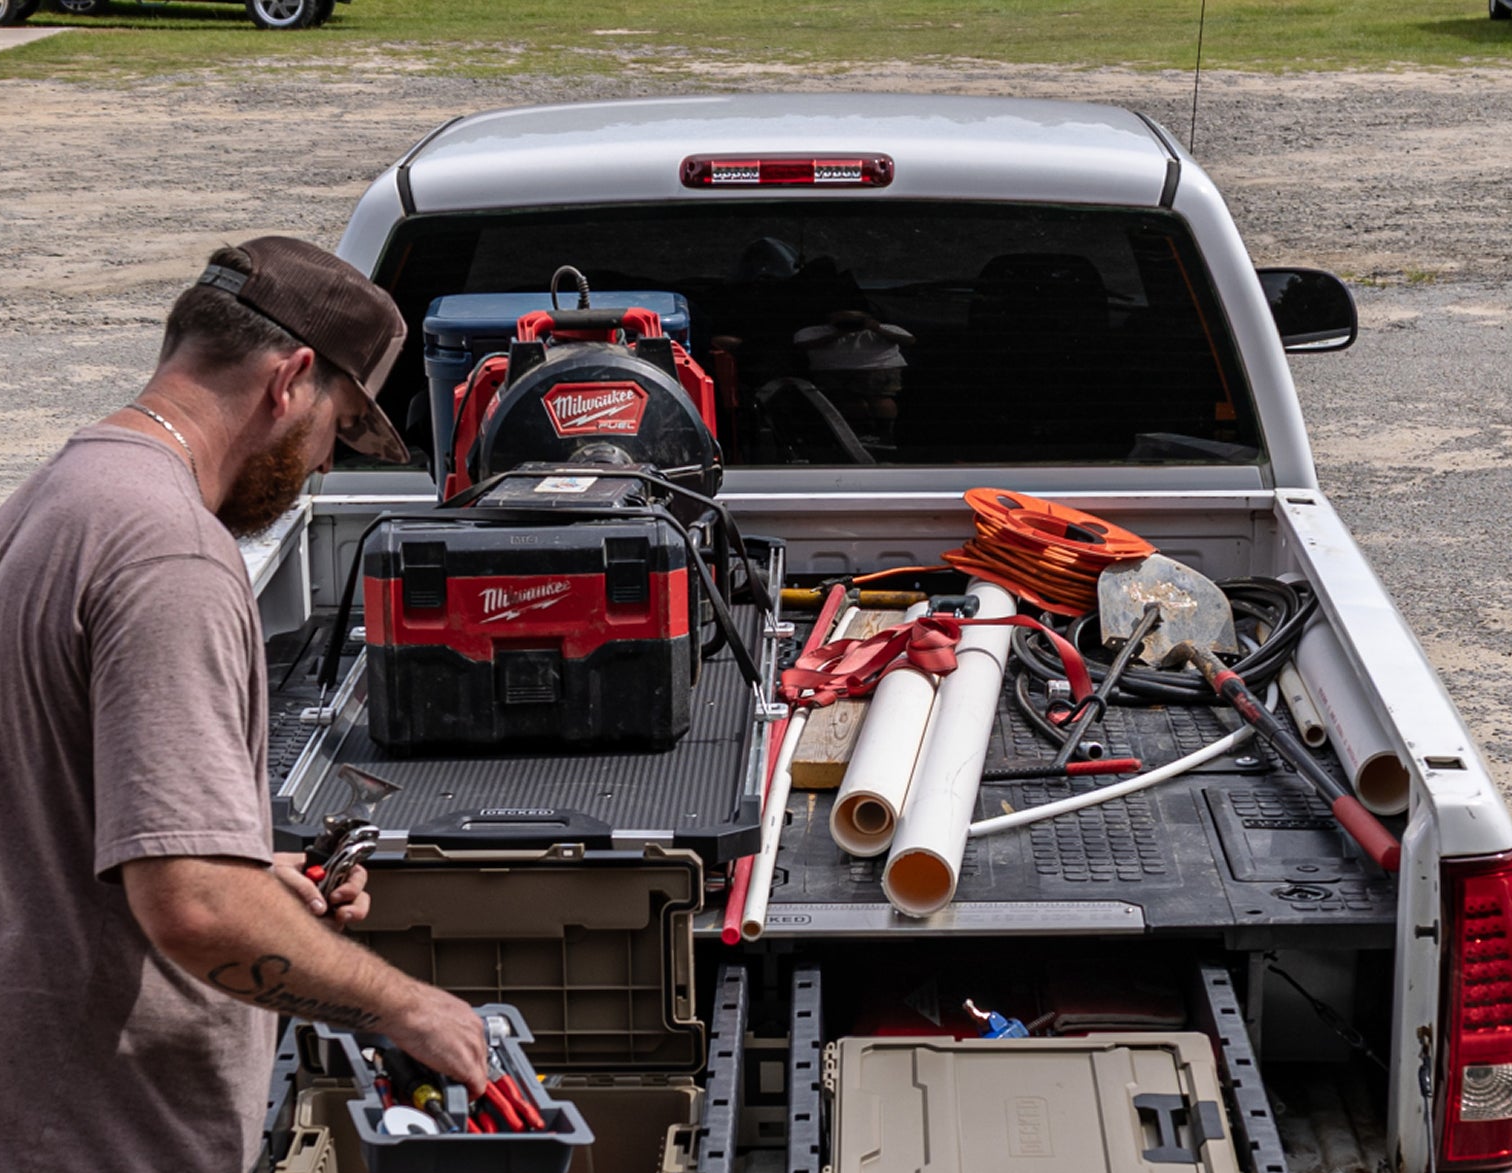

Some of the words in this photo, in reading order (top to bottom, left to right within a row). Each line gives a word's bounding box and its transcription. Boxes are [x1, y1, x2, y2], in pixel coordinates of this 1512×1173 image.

[553, 390, 635, 419] Milwaukee
[598, 421, 636, 430] FUEL
[1017, 1099, 1044, 1154] DECKED
